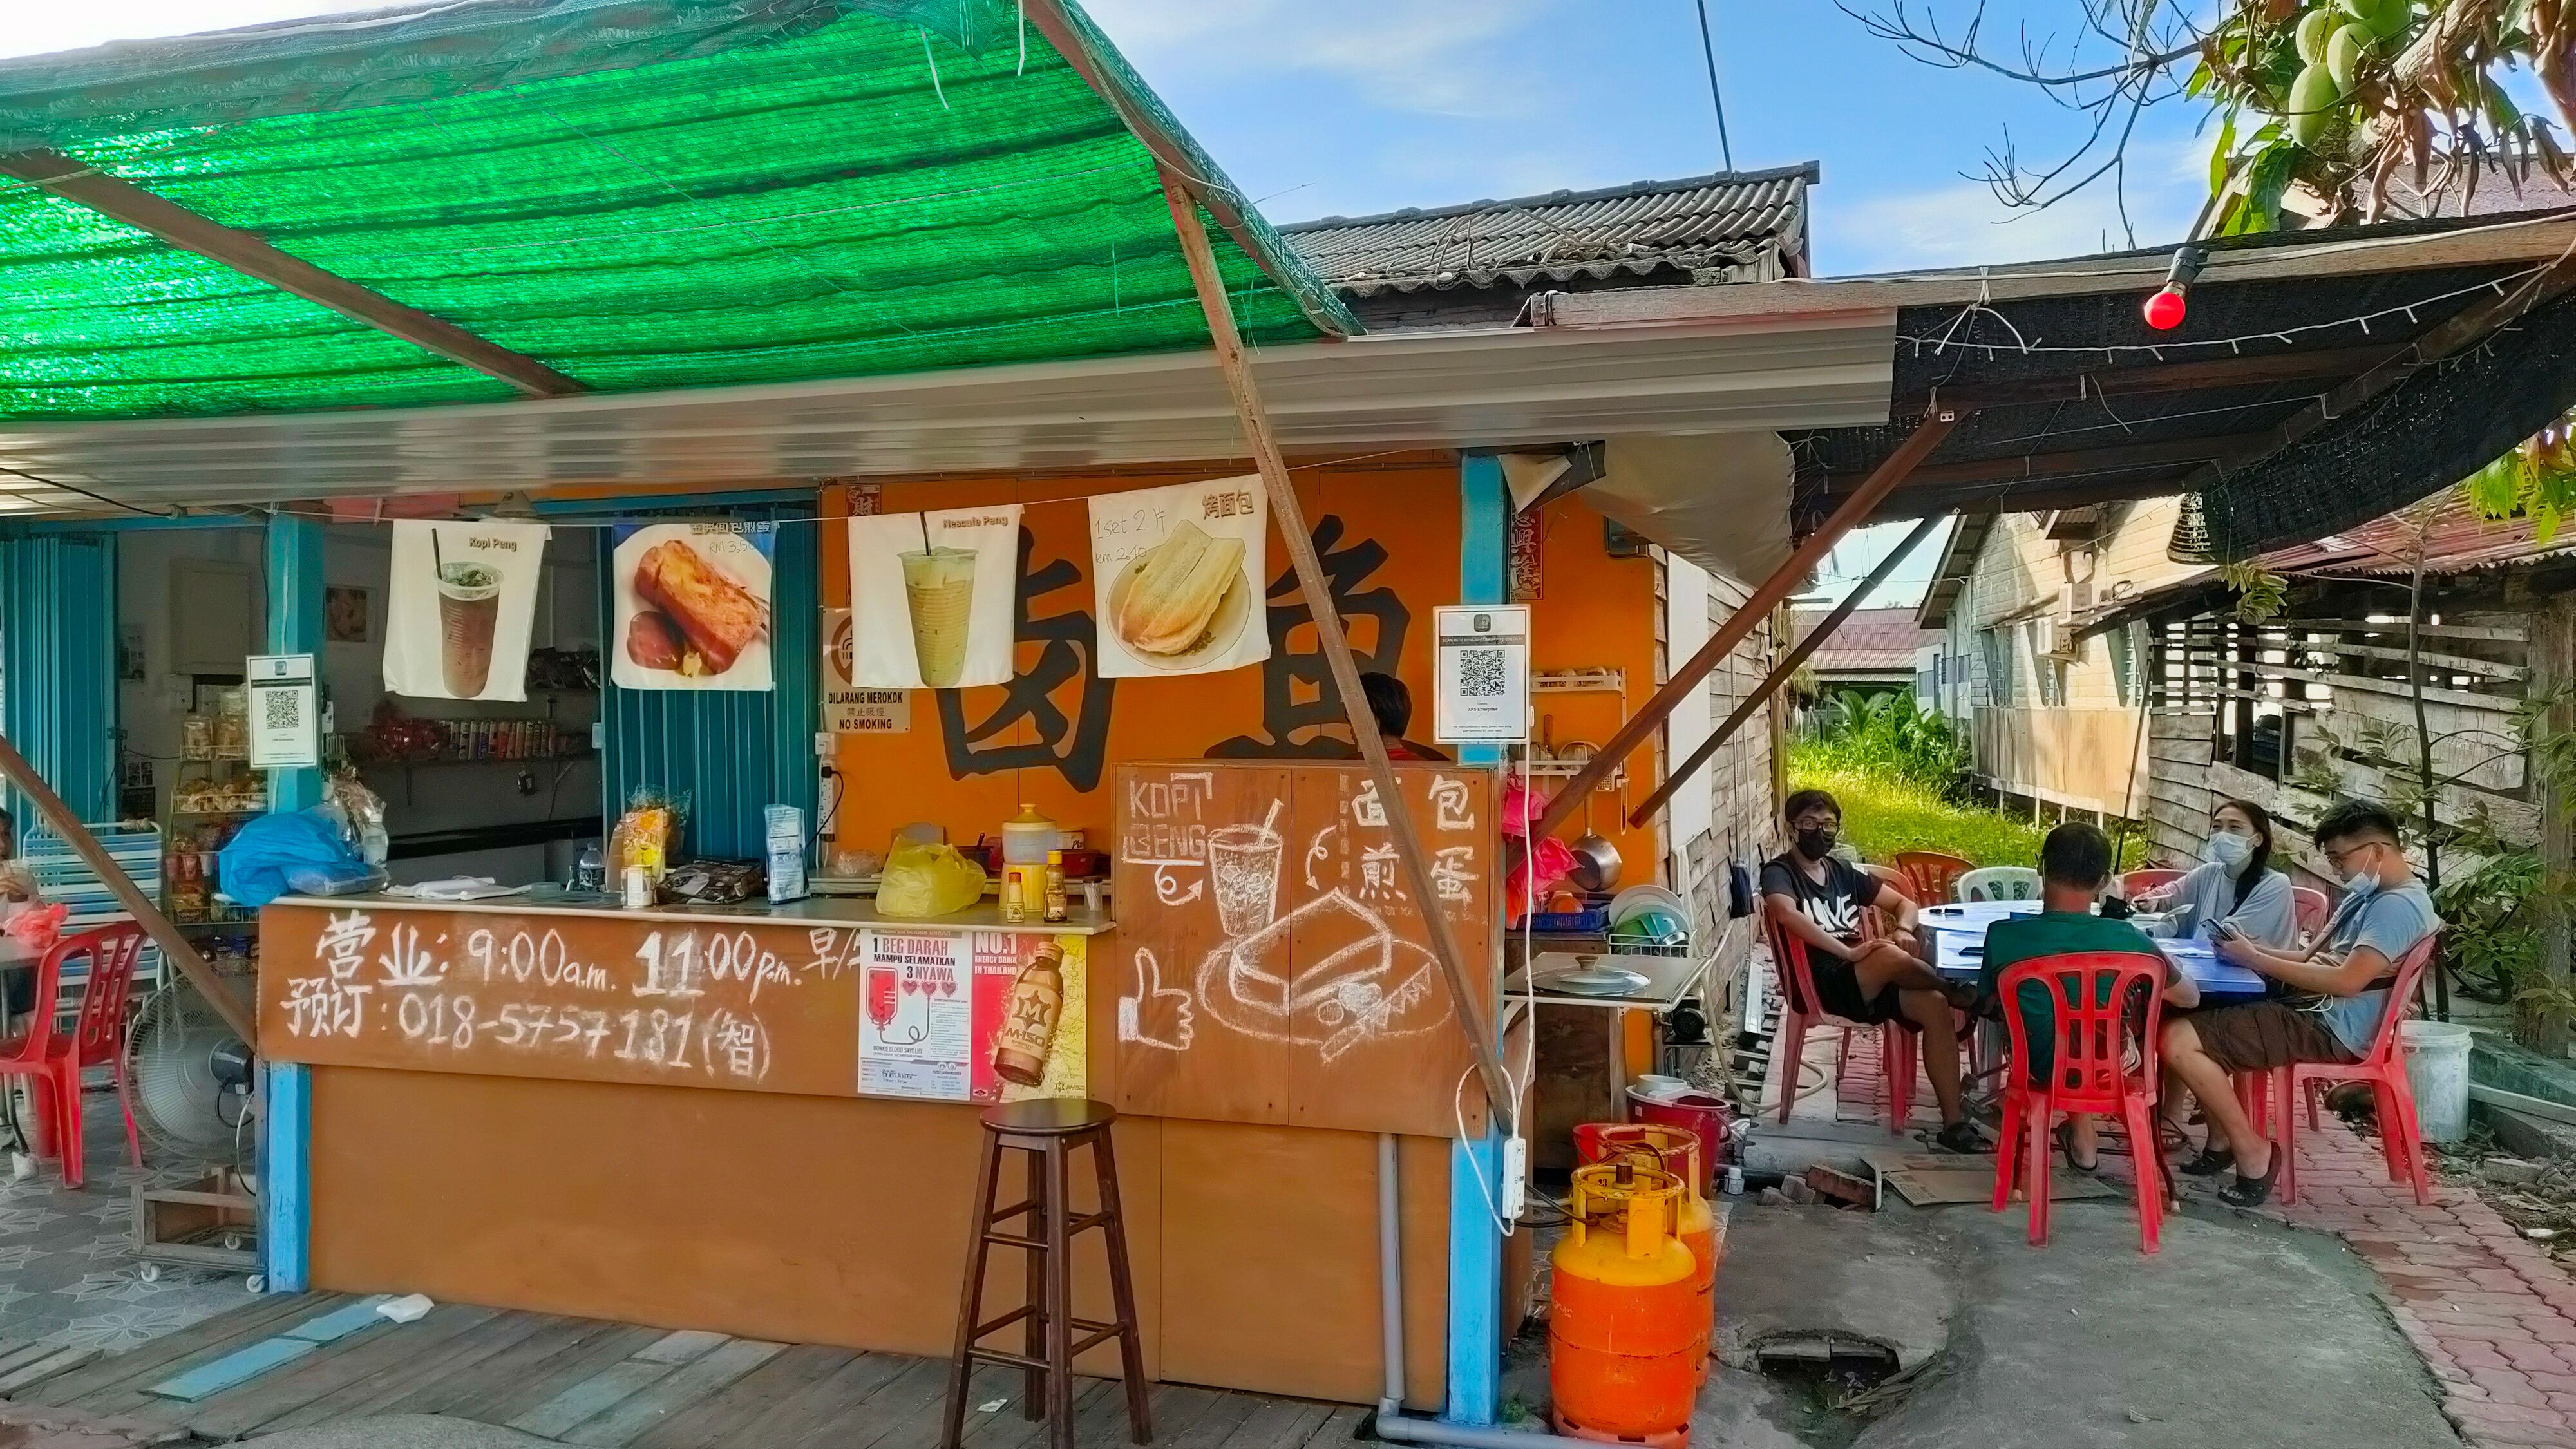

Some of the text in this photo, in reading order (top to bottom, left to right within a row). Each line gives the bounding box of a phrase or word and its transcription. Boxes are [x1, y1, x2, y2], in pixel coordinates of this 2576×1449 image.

[1202, 489, 1255, 520] 烤面包
[943, 516, 1009, 529] Nescafe Peng
[469, 536, 517, 552] Kopi Peng
[709, 540, 726, 554] RM
[828, 692, 903, 704] DILARANG MEROKOK
[839, 719, 892, 730] NO SMOKING
[1130, 780, 1202, 820] KOPI
[1130, 824, 1206, 858] BENG
[1359, 841, 1480, 909] 煎蛋
[873, 937, 948, 956] 1 BEG DARAH
[976, 932, 1017, 954] NO.1
[873, 954, 956, 967] MAMPU SELAMATKAN
[998, 956, 1018, 964] DRINK
[907, 966, 954, 981] 3 NYAWA
[974, 966, 1018, 975] IN THAILAND
